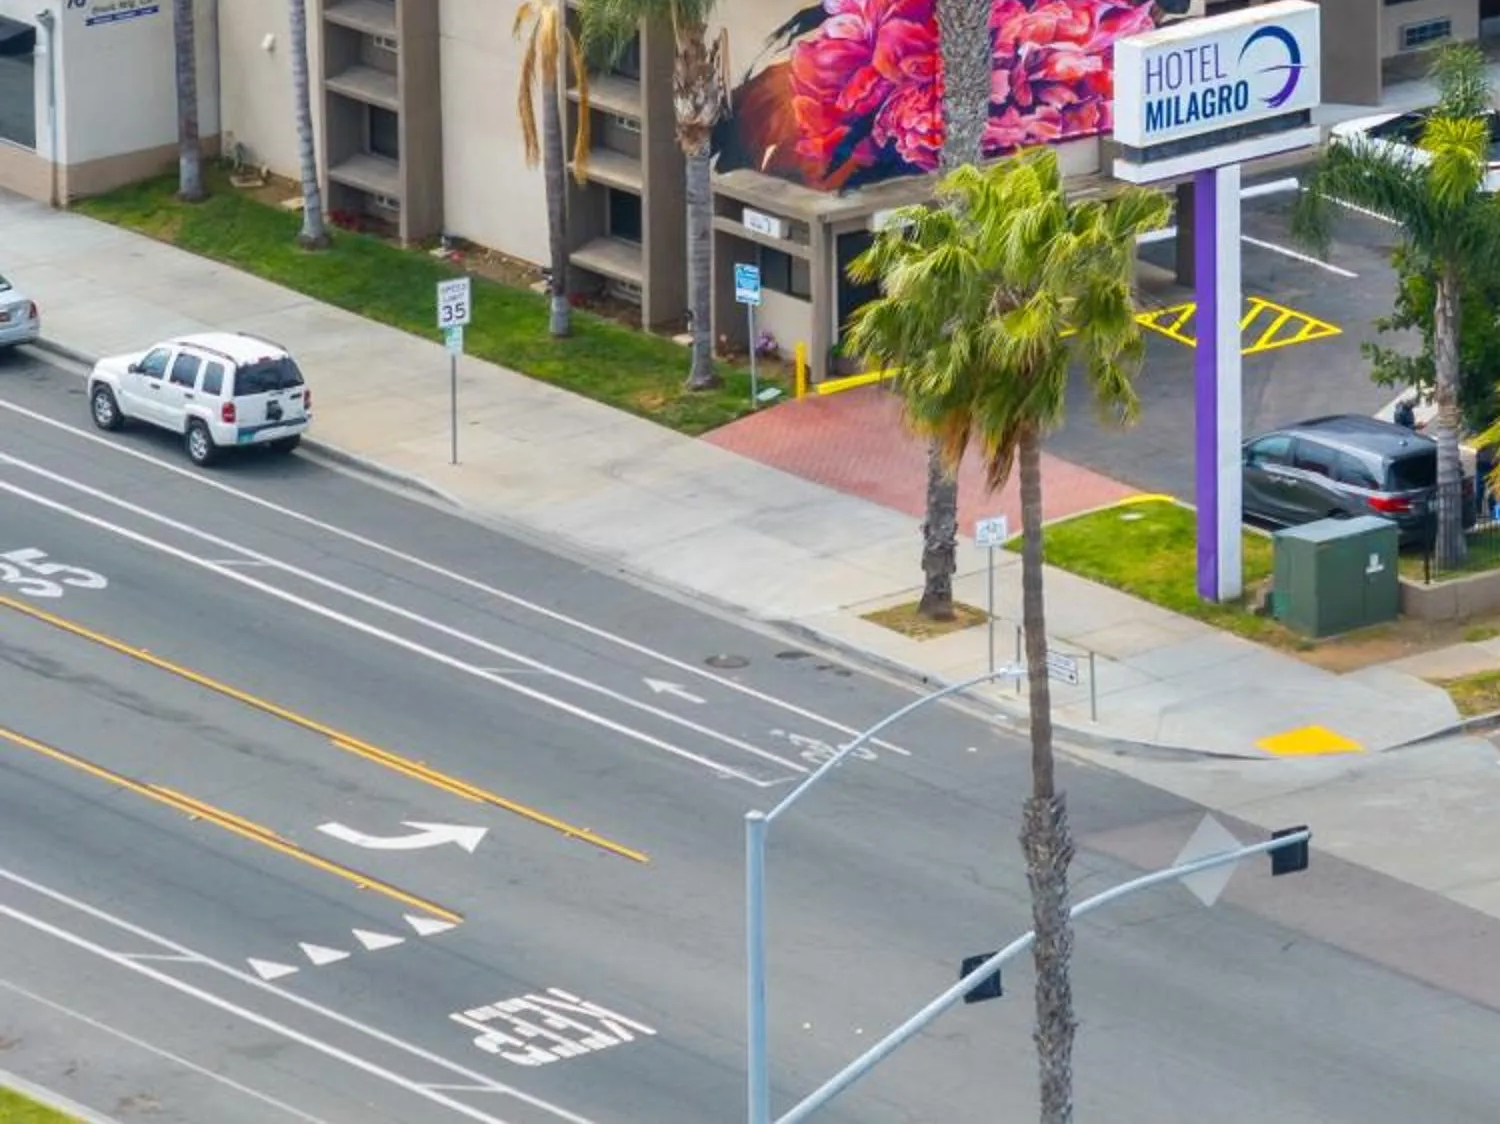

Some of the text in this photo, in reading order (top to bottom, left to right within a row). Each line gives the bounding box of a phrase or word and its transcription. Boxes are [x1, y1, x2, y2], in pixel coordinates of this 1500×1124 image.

[1145, 43, 1228, 95] HOTEL
[1145, 79, 1249, 133] MILAGRO
[442, 301, 466, 323] 35
[448, 987, 658, 1067] KEEP
